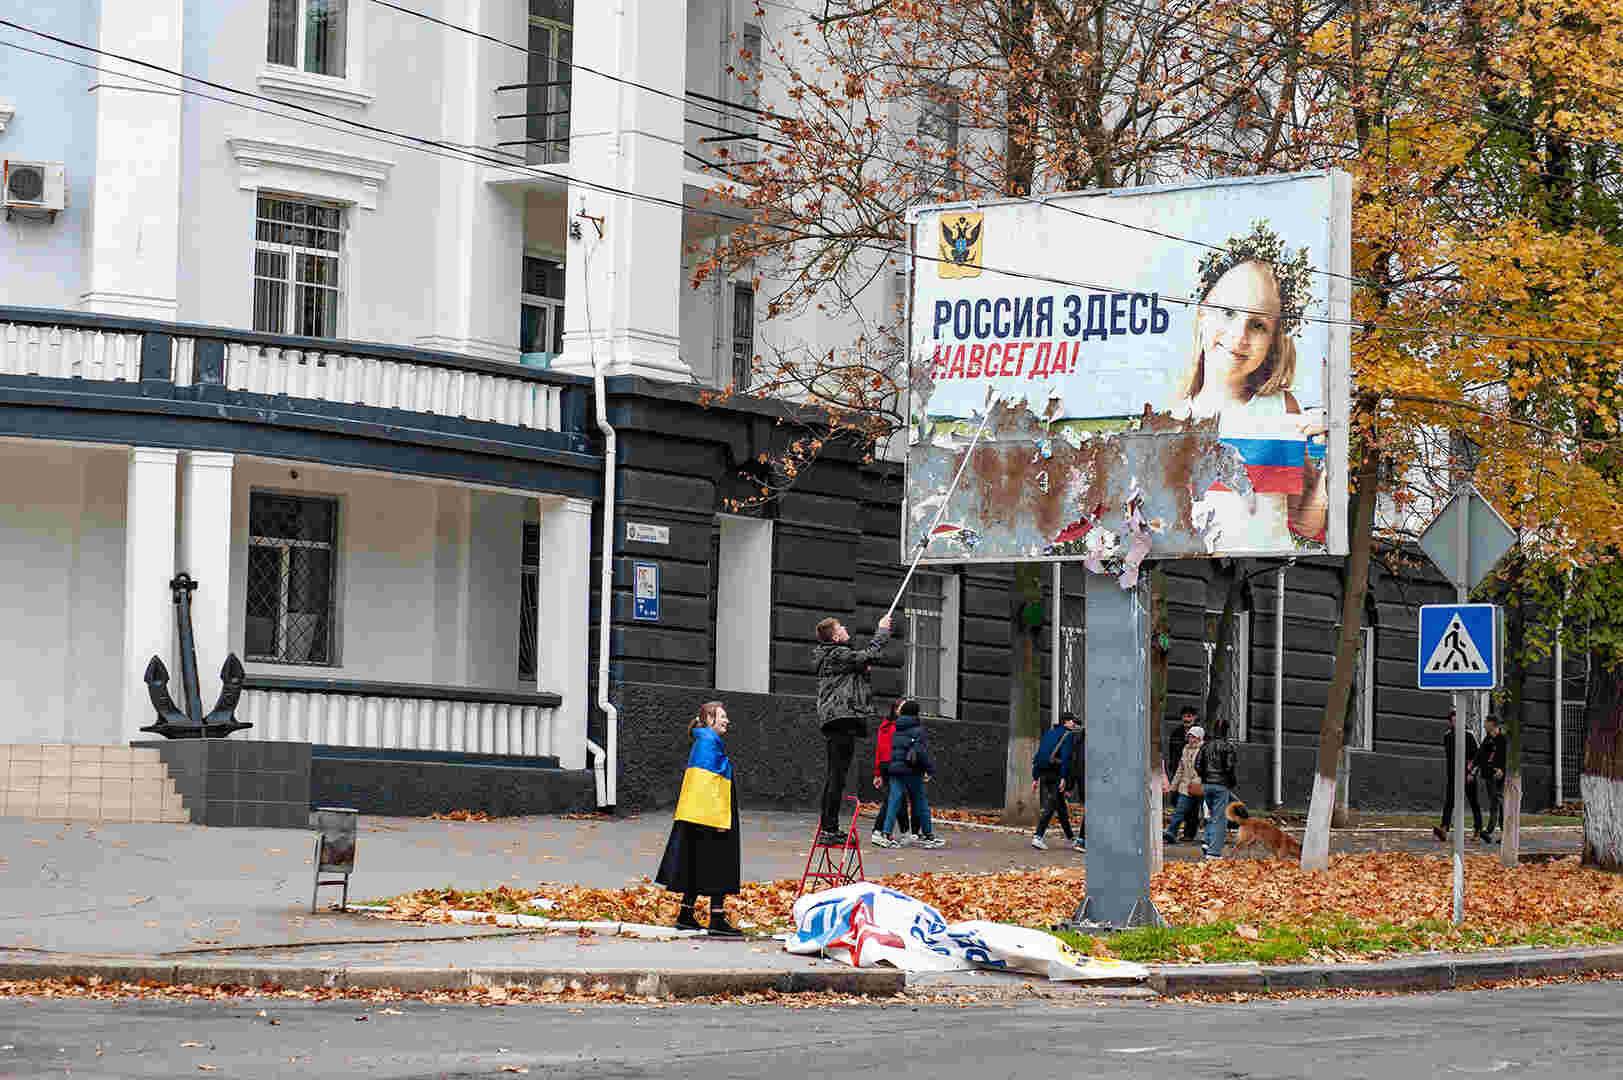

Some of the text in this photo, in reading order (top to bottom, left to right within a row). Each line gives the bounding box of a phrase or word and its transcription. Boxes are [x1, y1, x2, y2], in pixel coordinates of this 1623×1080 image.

[934, 293, 1170, 341] РОССИЯ ЗДЕСЬ
[932, 342, 1080, 379] НАВСЕГДА!
